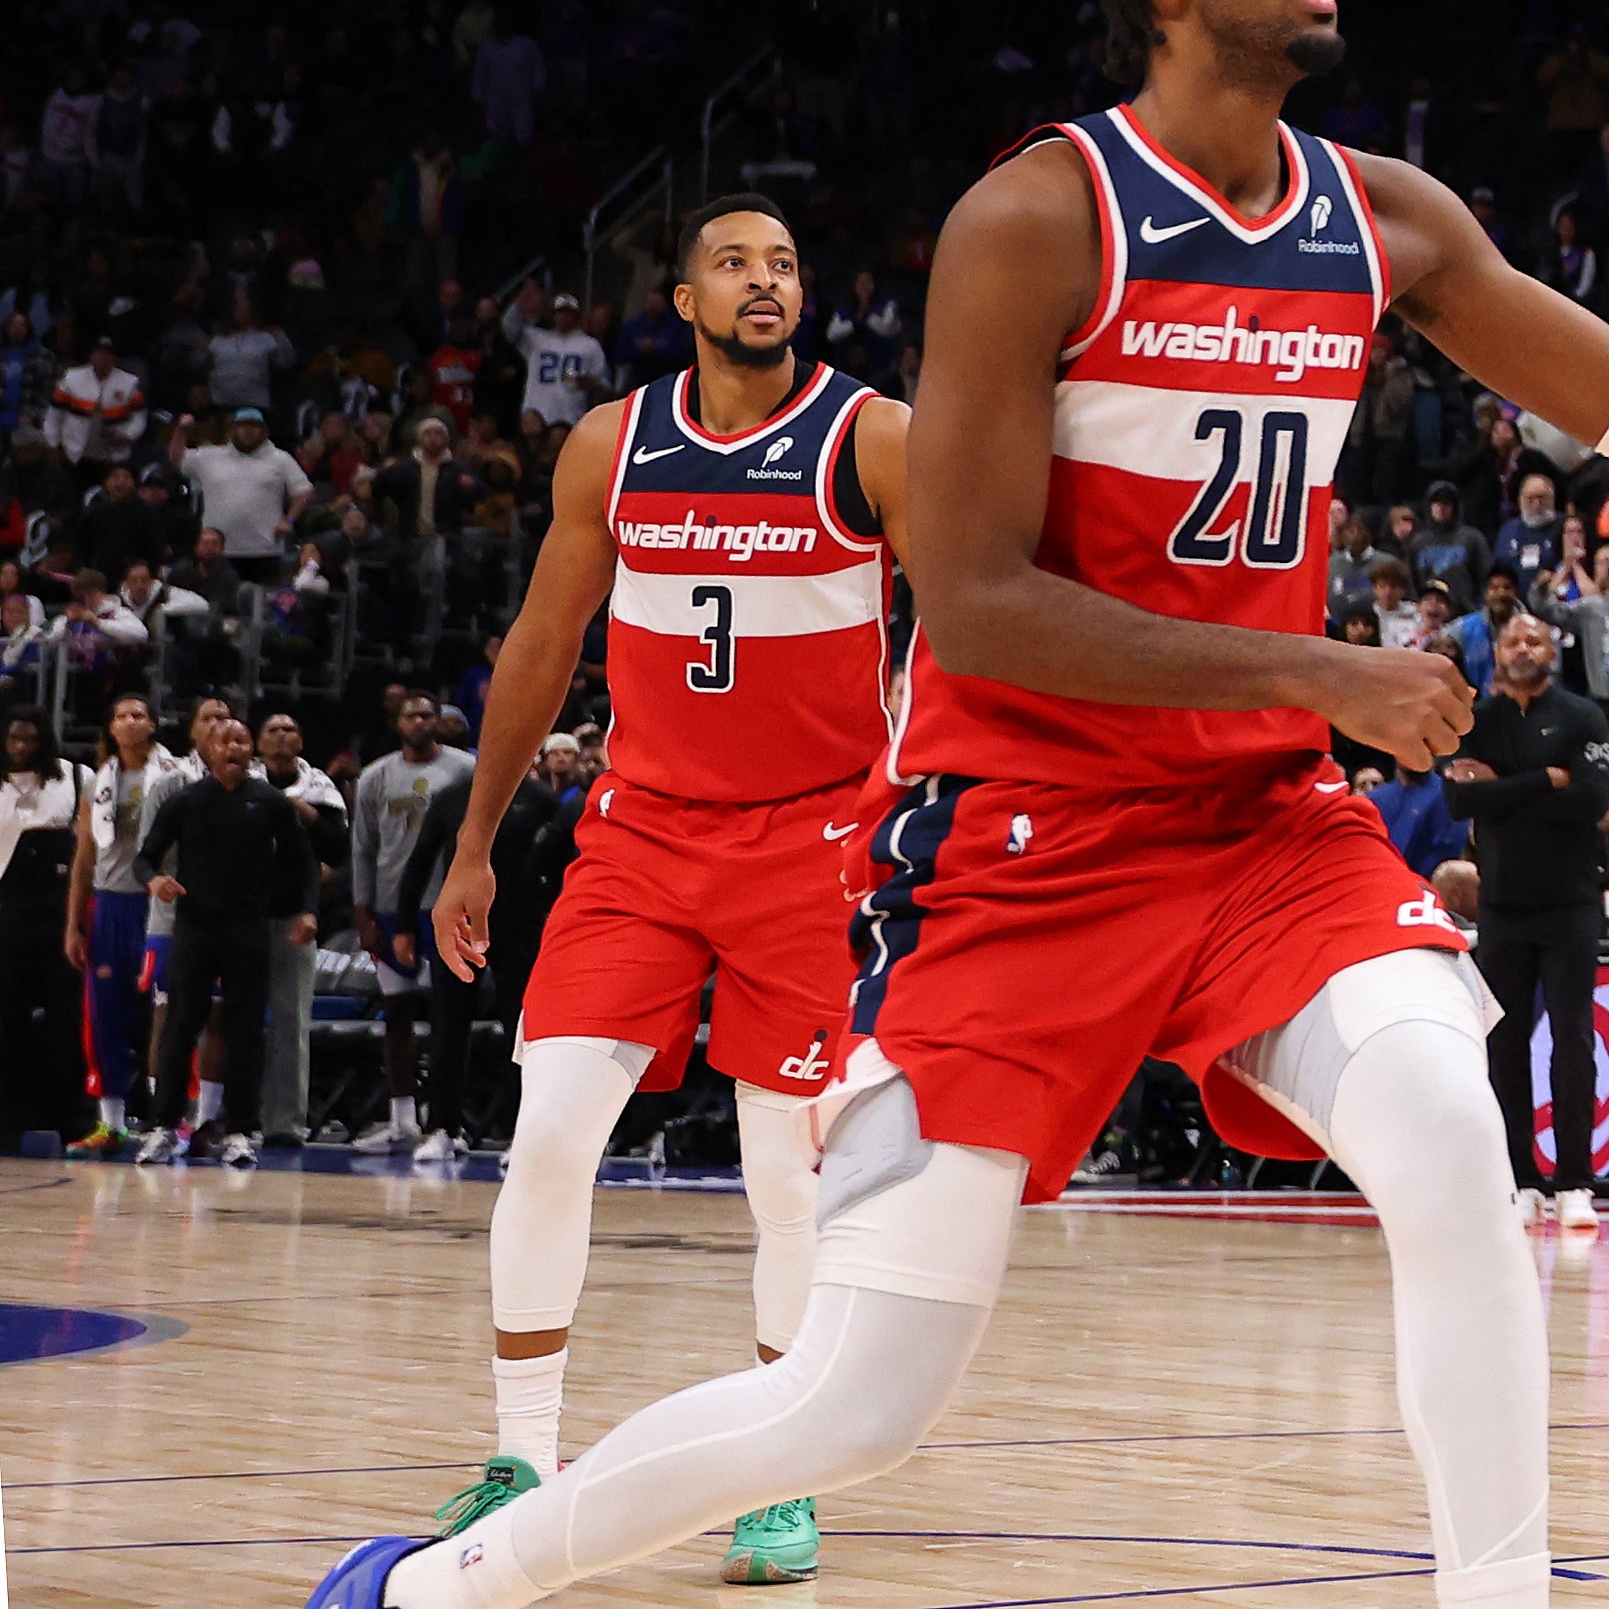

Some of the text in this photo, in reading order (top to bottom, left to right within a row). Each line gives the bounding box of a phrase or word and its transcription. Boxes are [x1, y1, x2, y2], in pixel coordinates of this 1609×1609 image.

[1298, 238, 1360, 256] Robinhood
[1121, 304, 1364, 382] washington
[747, 469, 802, 481] Robinhood
[1167, 404, 1309, 570] 20
[618, 510, 817, 561] washington
[687, 583, 735, 694] 3
